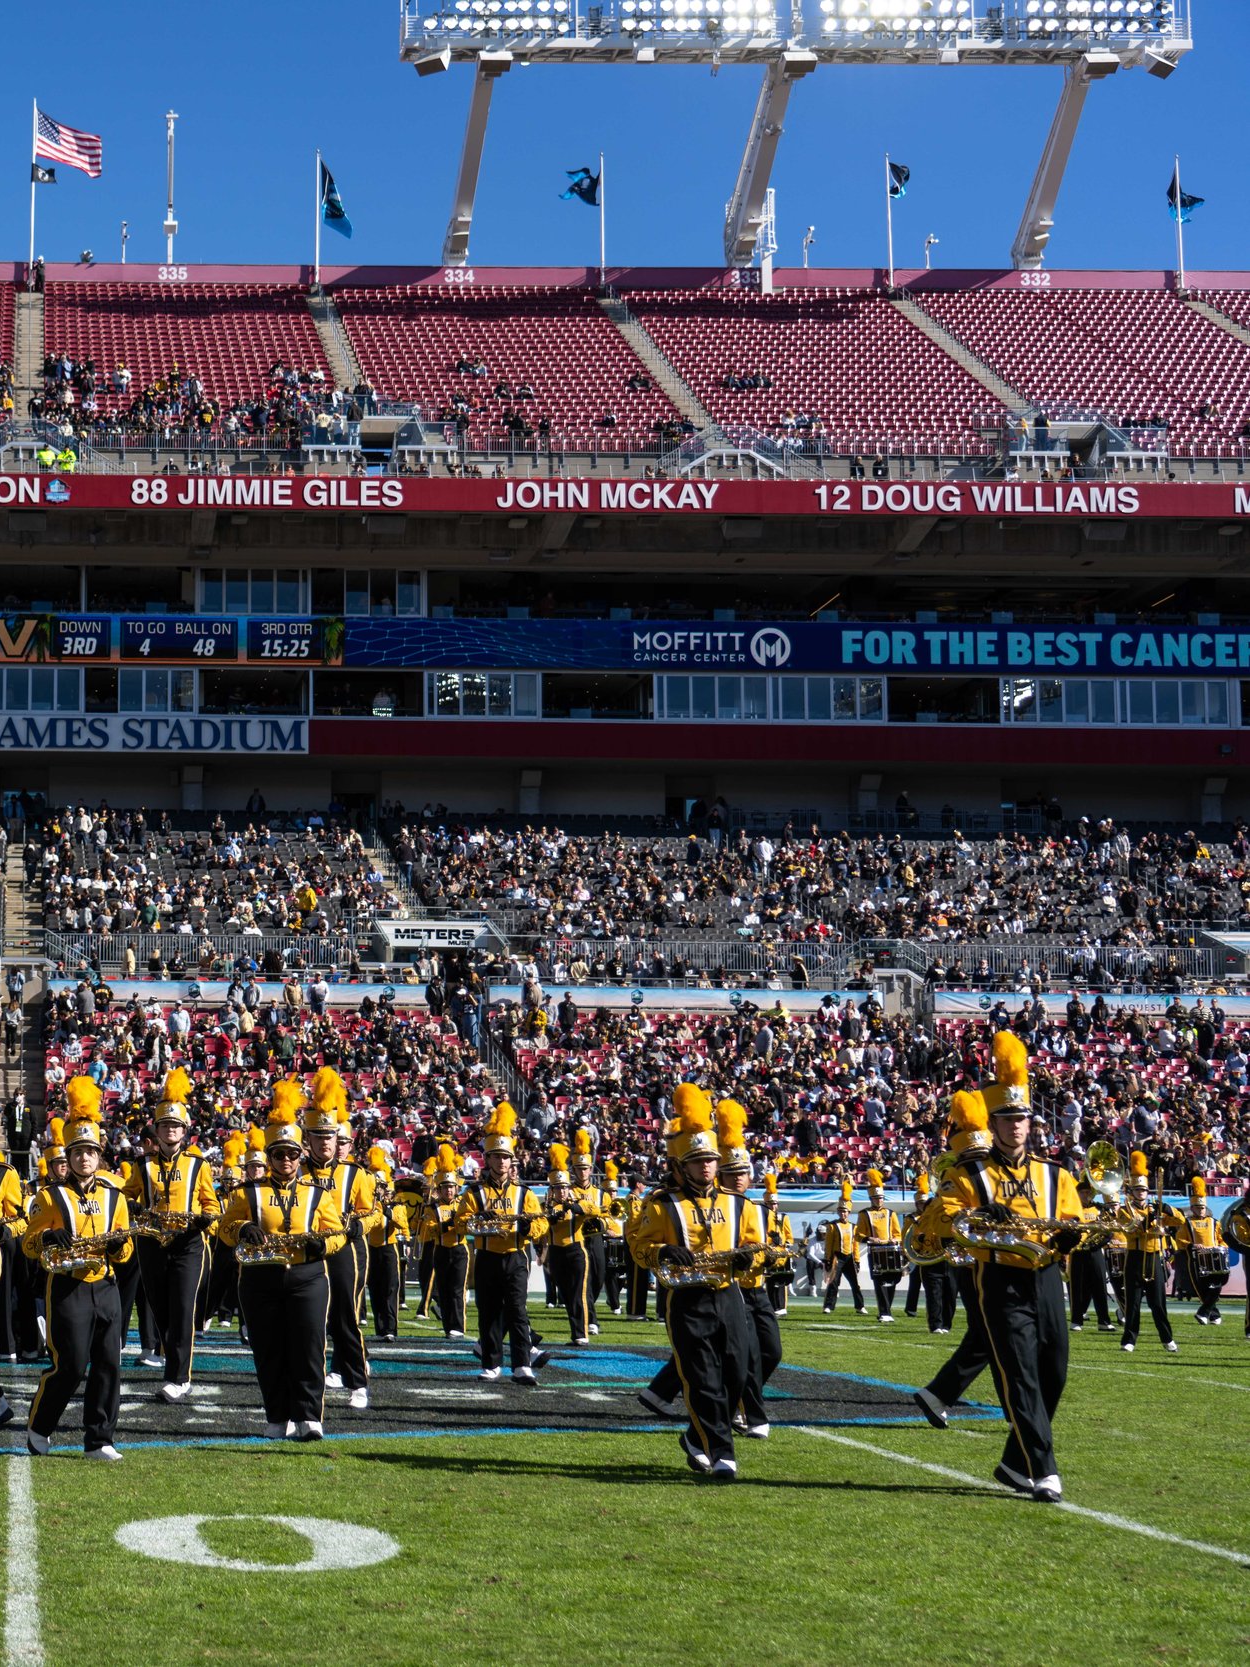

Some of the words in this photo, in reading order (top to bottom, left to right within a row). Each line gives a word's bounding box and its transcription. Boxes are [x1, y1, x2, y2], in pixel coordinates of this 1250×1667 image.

[157, 265, 188, 281] 335
[444, 269, 475, 284] 334
[731, 270, 760, 284] 333
[1019, 272, 1051, 287] 332
[131, 478, 169, 504] 88
[178, 478, 293, 506] JIMMIE
[303, 480, 404, 507] GILES
[496, 481, 589, 509] JOHN
[600, 482, 720, 510] MCKAY
[814, 484, 851, 510] 12
[861, 486, 962, 512] DOUG
[970, 486, 1141, 514] WILLIAMS
[58, 621, 102, 634] DOWN
[126, 622, 144, 634] TO
[148, 622, 166, 635] GO
[175, 623, 209, 635] BALL
[212, 623, 232, 636] ON
[261, 623, 286, 635] 3RD
[289, 623, 313, 636] QTR
[62, 637, 97, 655] 3RD
[139, 638, 151, 656] 4
[193, 638, 216, 657] 48
[260, 639, 311, 658] 15:25
[633, 631, 745, 651] MOFFITT
[841, 630, 918, 664] FOR
[923, 631, 999, 665] THE
[1006, 632, 1103, 667] BEST
[633, 652, 687, 662] CANCER
[693, 653, 746, 663] CENTER
[122, 718, 307, 752] STADIUM
[394, 928, 475, 940] METERS
[115, 1514, 402, 1572] 0
